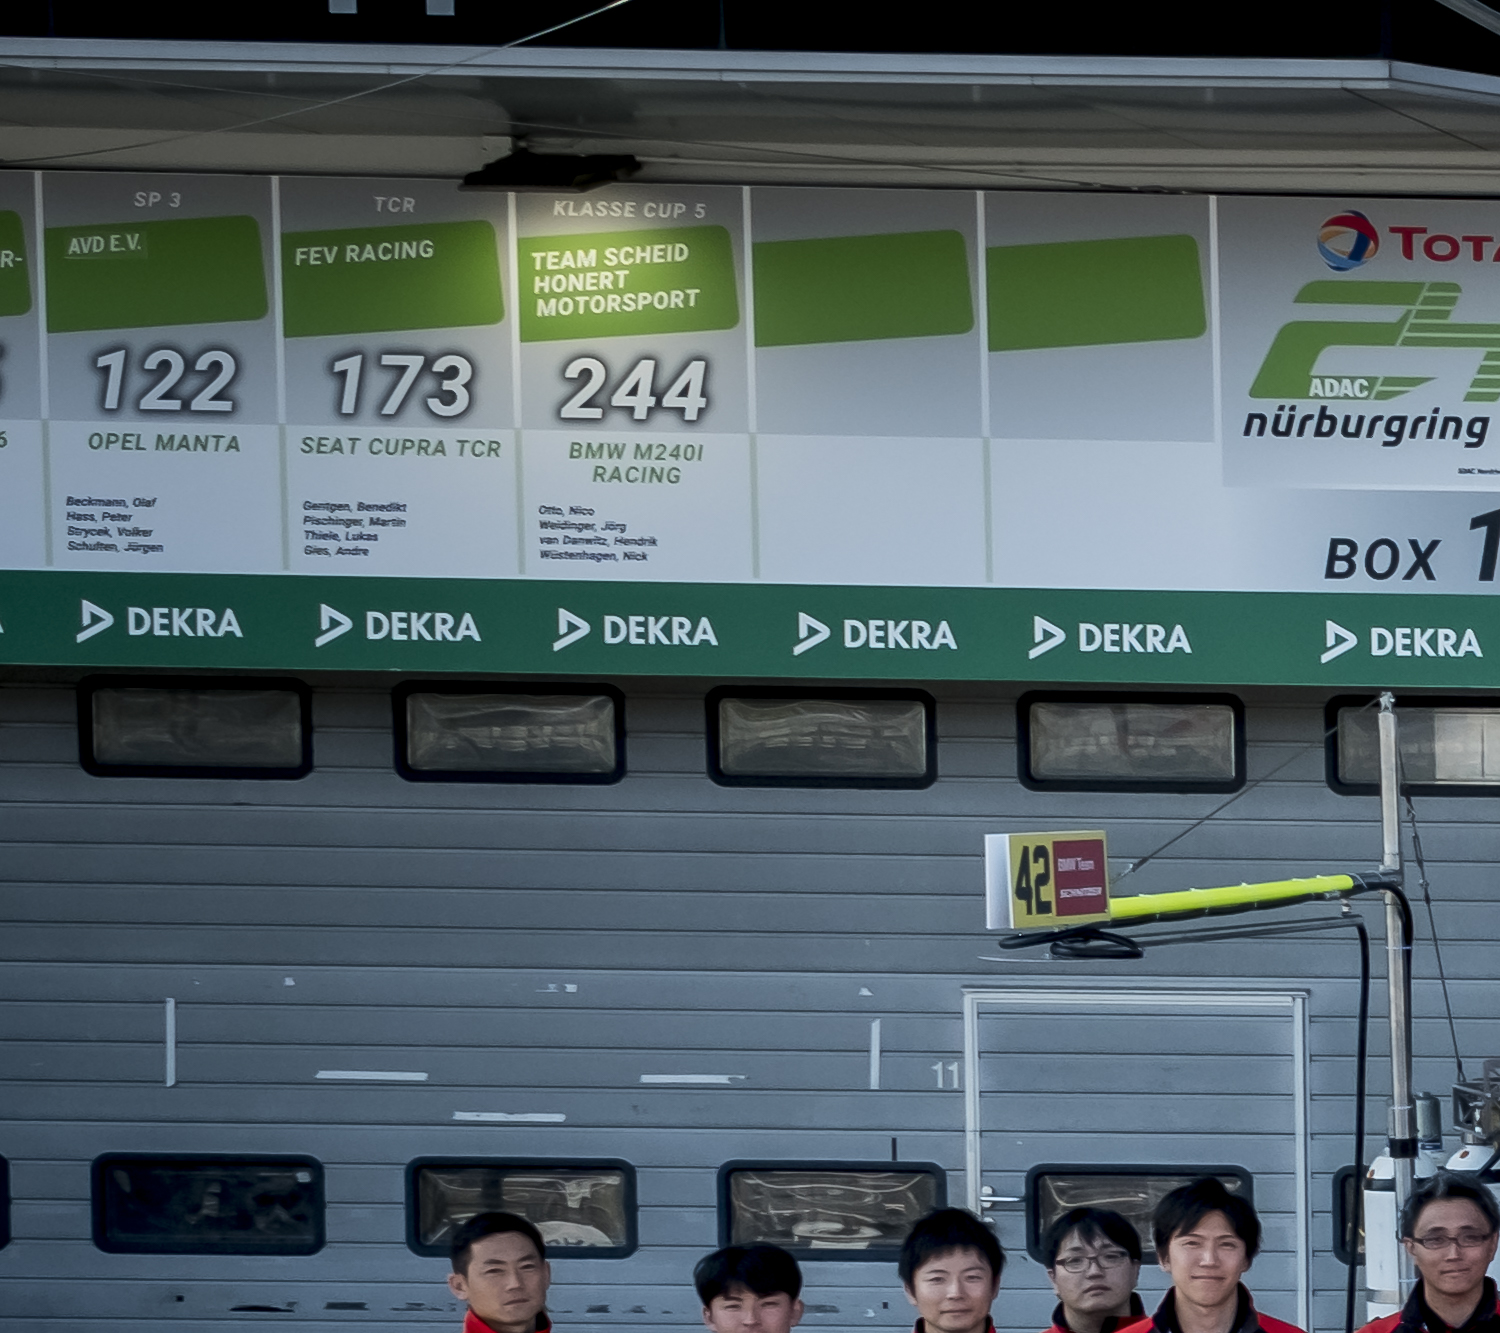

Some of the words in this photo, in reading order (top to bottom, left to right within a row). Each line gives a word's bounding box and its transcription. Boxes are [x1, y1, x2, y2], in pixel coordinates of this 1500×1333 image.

[375, 196, 415, 212] TCR
[554, 200, 636, 218] KLASSE
[642, 201, 686, 218] CUP
[695, 204, 705, 219] 5
[296, 246, 339, 266] FEV
[345, 241, 434, 262] RACING
[532, 249, 596, 270] TEAM
[603, 244, 689, 266] SCHEID
[535, 271, 628, 293] HONERT
[536, 289, 700, 316] MOTORSPORT
[95, 349, 237, 412] 122
[332, 355, 474, 417] 173
[560, 358, 707, 421] 244
[1310, 377, 1369, 398] ADAC
[1244, 406, 1490, 447] nürburgring
[88, 434, 148, 451] OPEL
[155, 434, 240, 453] MANTA
[301, 437, 361, 454] SEAT
[369, 438, 446, 456] CUPRA
[454, 440, 501, 457] TCR
[569, 443, 628, 461] BMW
[593, 465, 681, 484] RACING
[1325, 538, 1441, 580] BOX
[128, 608, 242, 638] DEKRA
[604, 616, 718, 646] DEKRA
[1371, 627, 1482, 657] DEKRA
[1016, 845, 1052, 915] 42
[932, 1062, 958, 1088] 11
